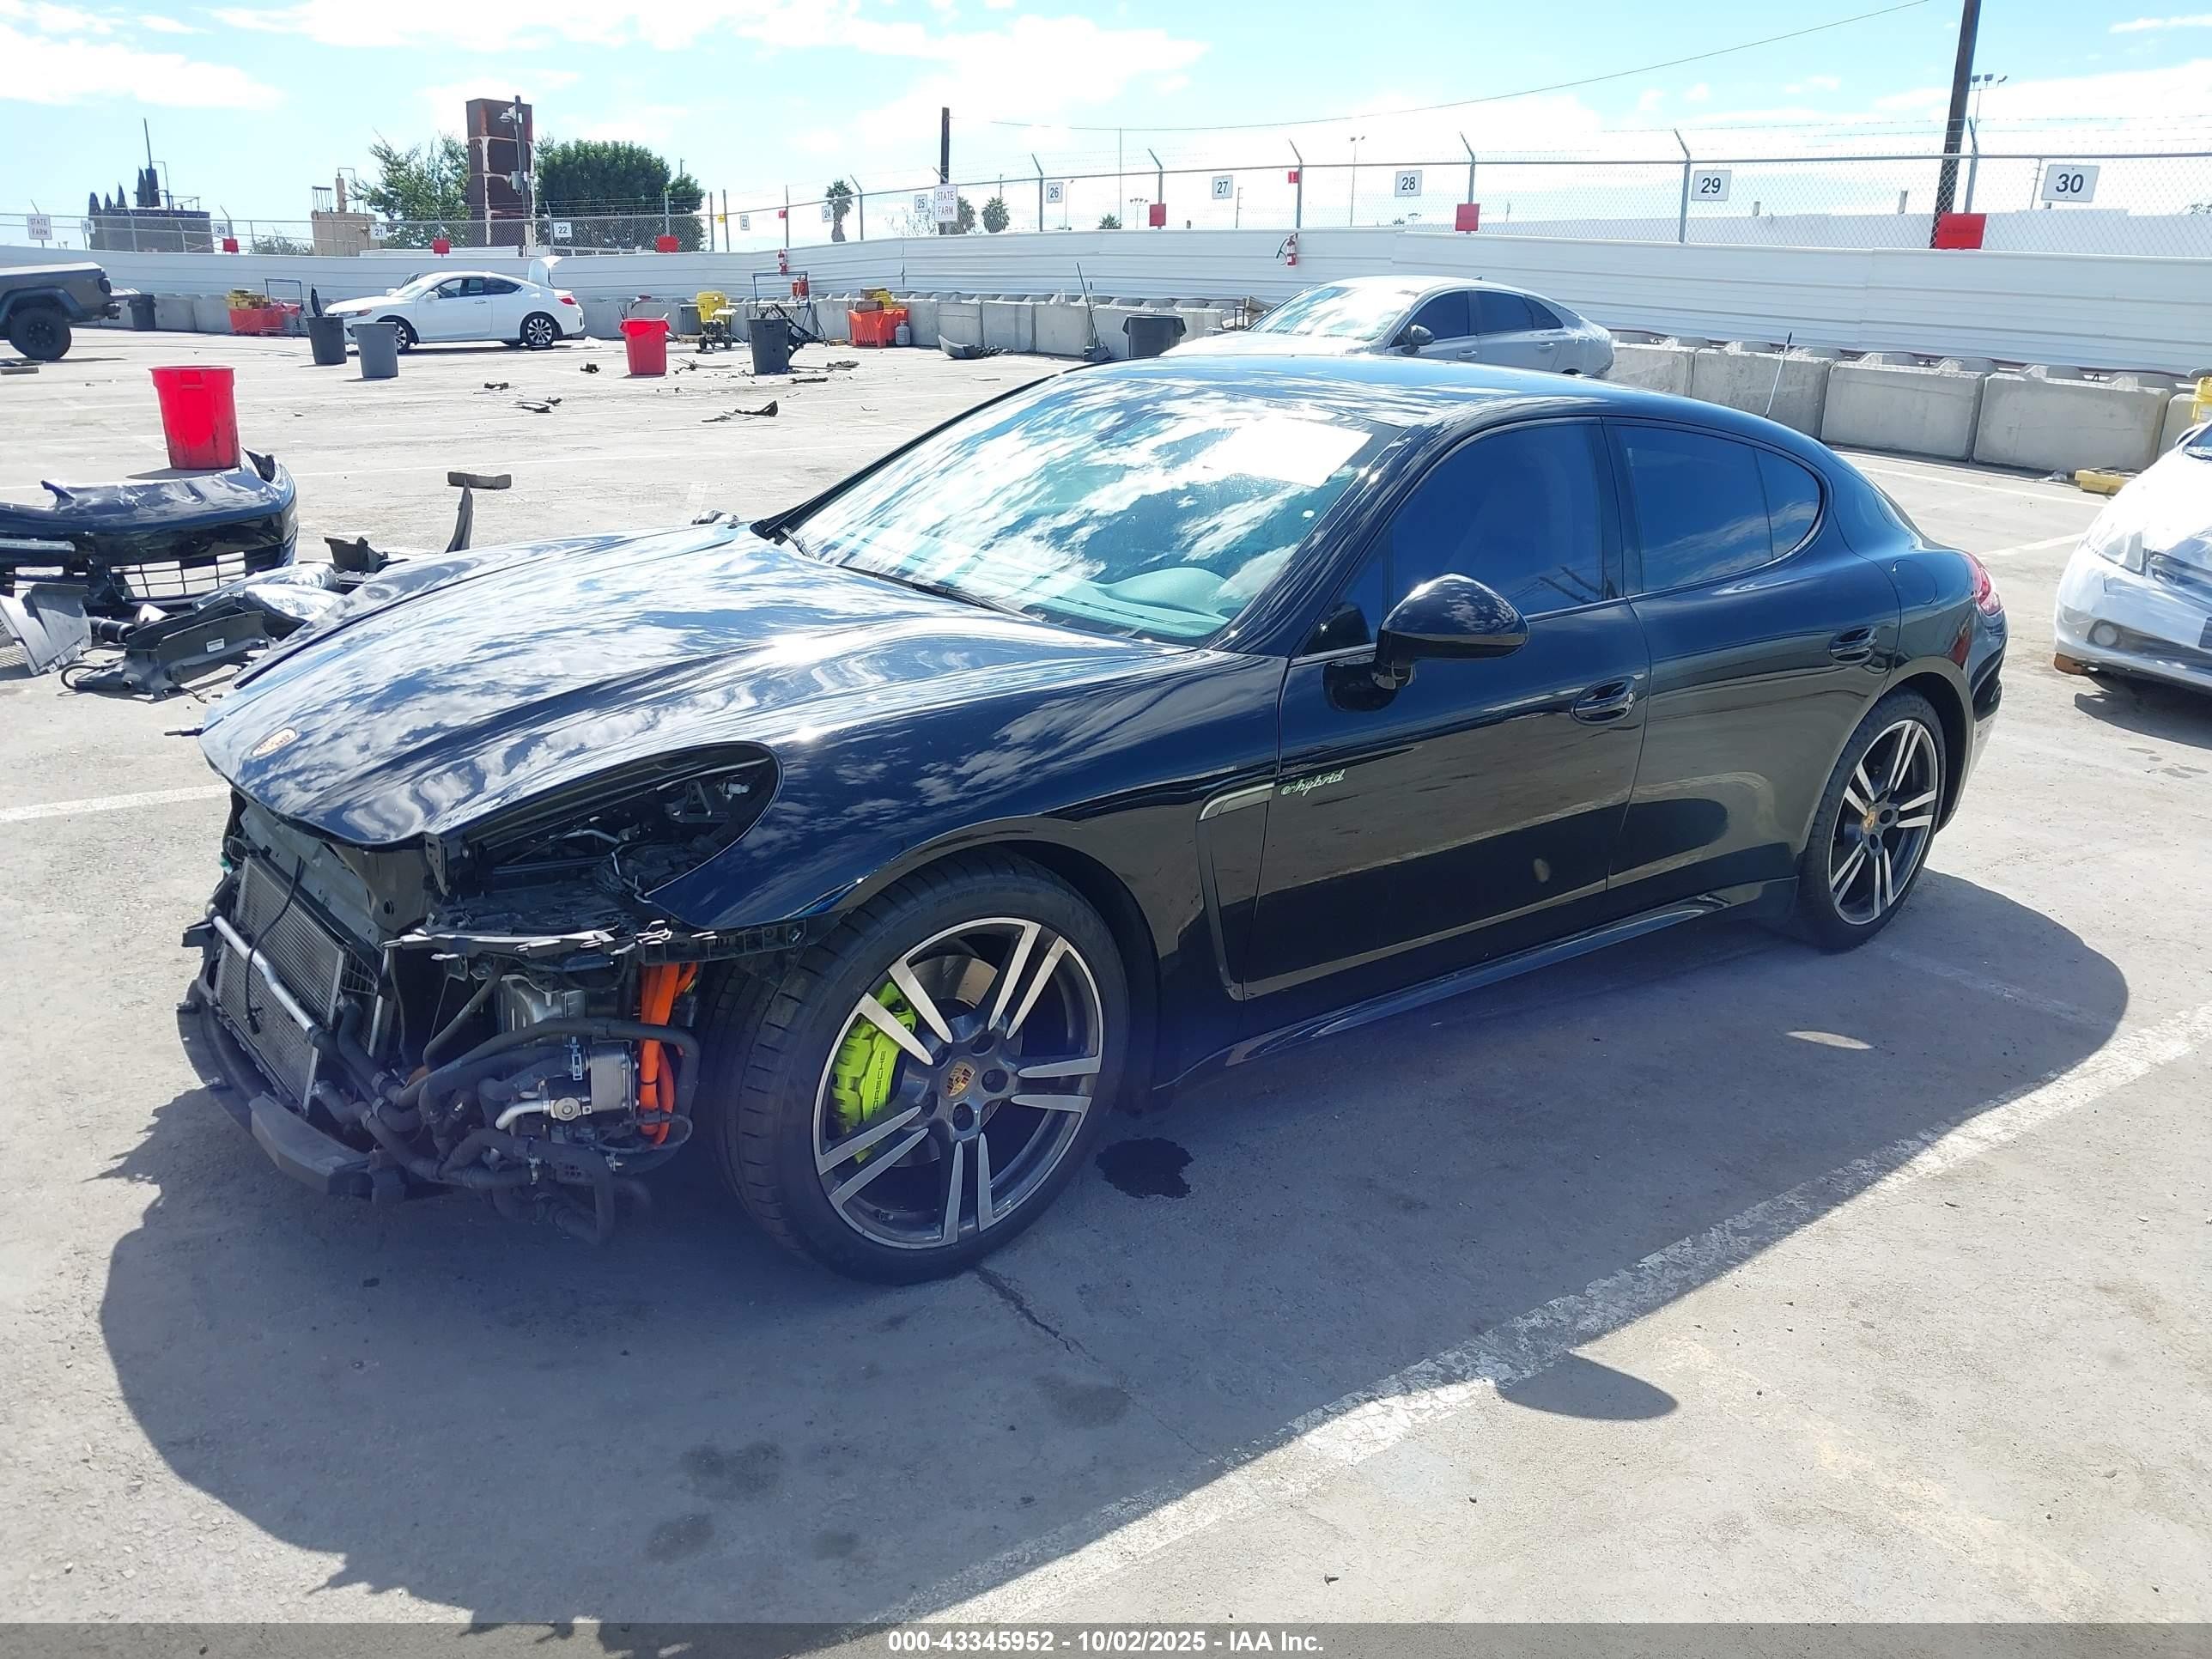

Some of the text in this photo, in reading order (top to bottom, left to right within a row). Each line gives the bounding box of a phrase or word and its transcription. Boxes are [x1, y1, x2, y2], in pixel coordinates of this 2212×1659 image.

[1217, 180, 1229, 194] 27
[1401, 176, 1416, 191] 28
[1700, 177, 1722, 194] 29
[2055, 173, 2085, 194] 30
[937, 191, 955, 202] STATE
[1049, 186, 1060, 198] 26
[917, 198, 926, 209] 25
[938, 205, 955, 216] FARM
[216, 226, 226, 234] 20
[374, 228, 384, 237] 21
[557, 225, 568, 234] 22
